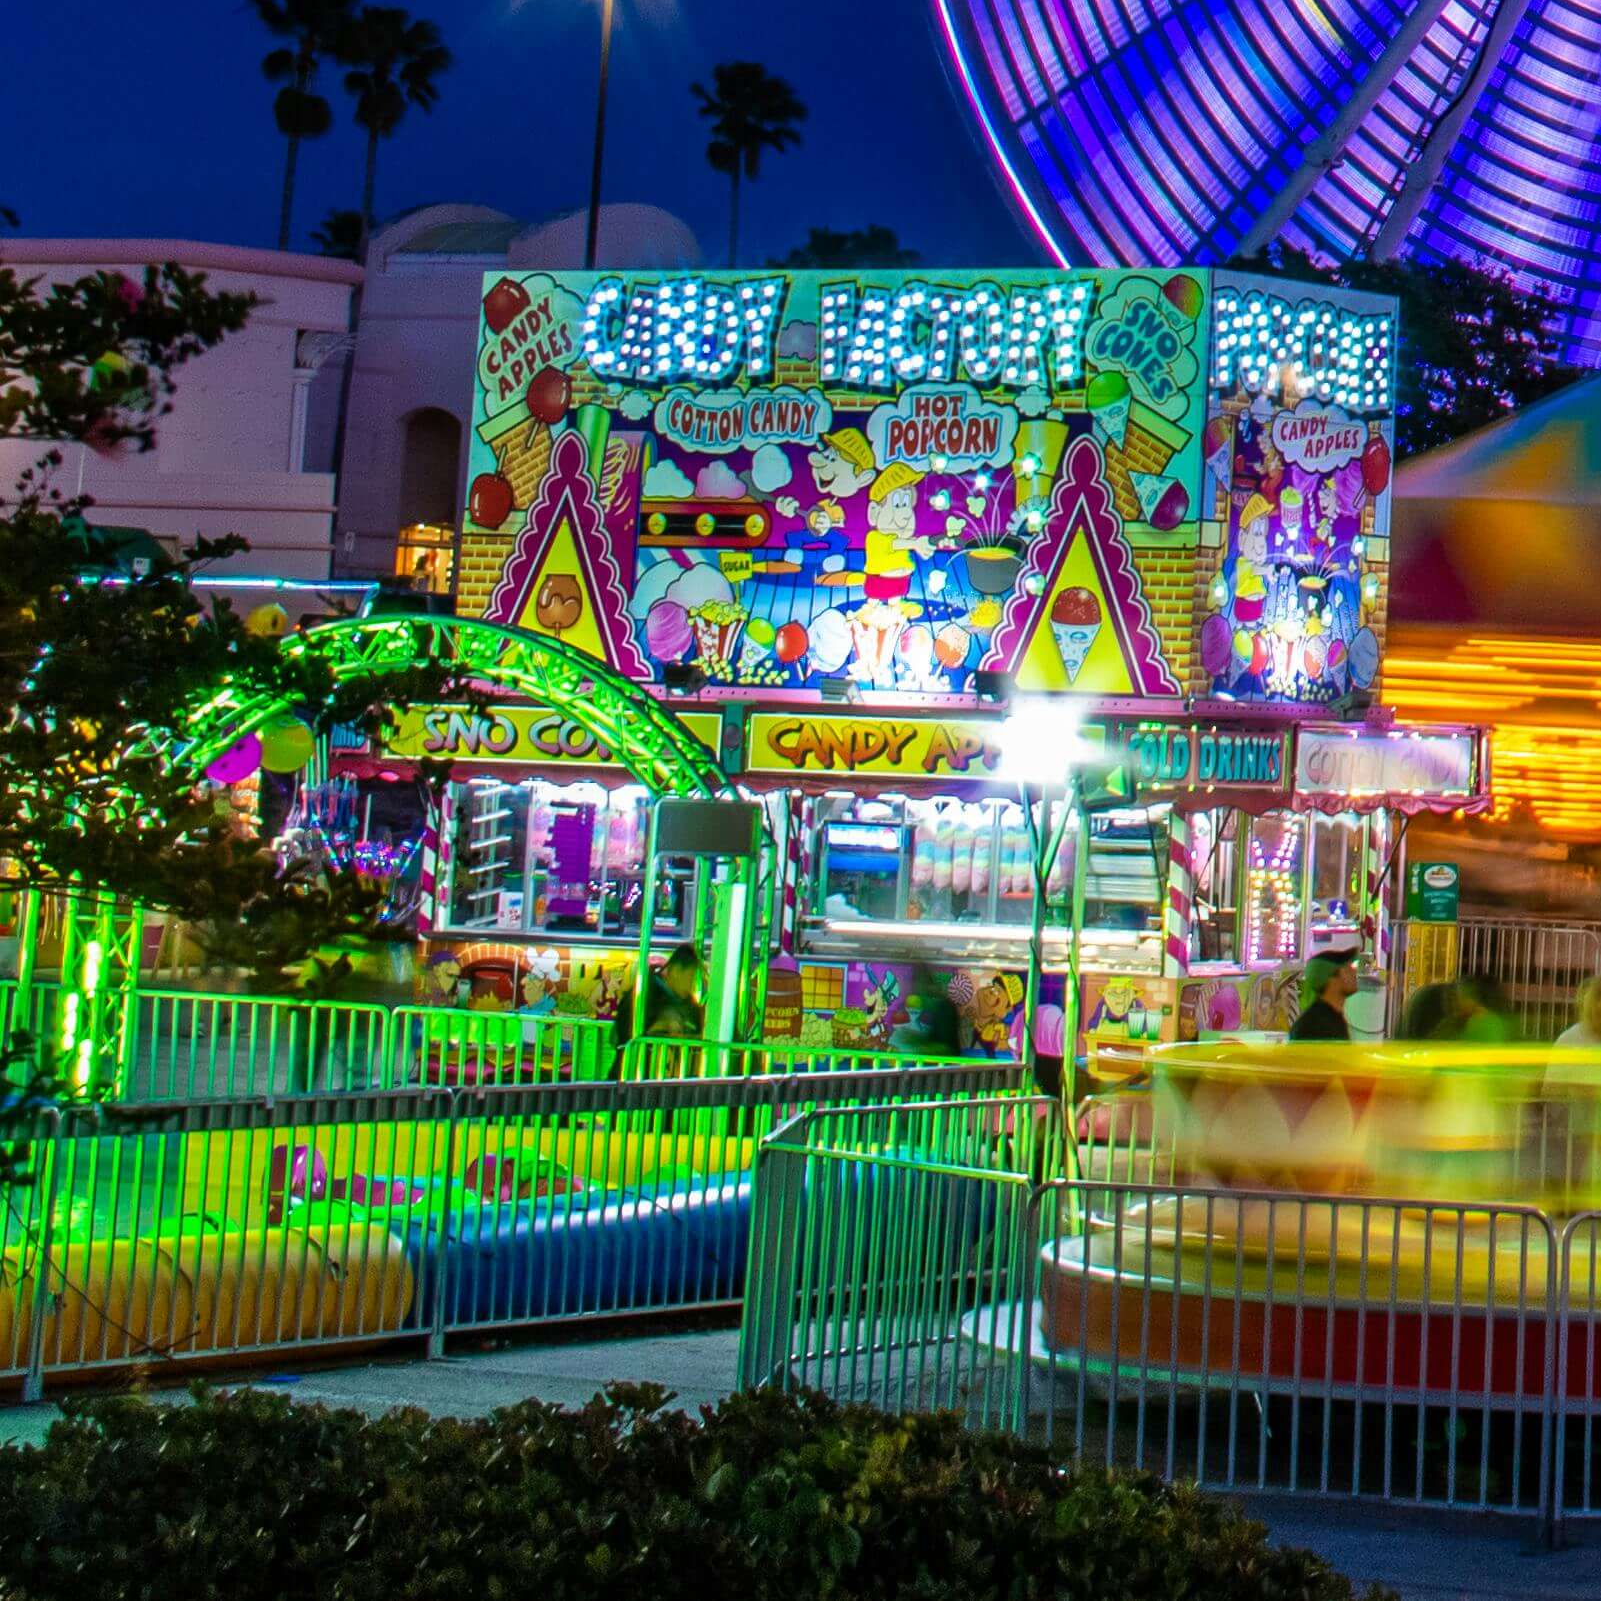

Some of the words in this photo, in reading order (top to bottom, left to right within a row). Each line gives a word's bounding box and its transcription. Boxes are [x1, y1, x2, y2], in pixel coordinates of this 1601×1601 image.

[487, 297, 554, 374] CANDY
[585, 276, 787, 384] CANDY
[819, 279, 1098, 387] FACTORY
[1125, 302, 1178, 358] SNO
[500, 323, 573, 400] APPLES
[1096, 324, 1173, 400] CONES
[670, 399, 743, 442] COTTON
[750, 401, 817, 435] CANDY
[914, 395, 963, 418] HOT
[1280, 415, 1328, 441] CANDY
[889, 417, 999, 456] POPCORN
[1304, 429, 1360, 458] APPLES
[723, 560, 750, 572] SUGAR
[423, 711, 517, 755] SNO
[530, 715, 613, 761] CO
[767, 718, 918, 771] CANDY
[1200, 734, 1281, 781] DRINKS
